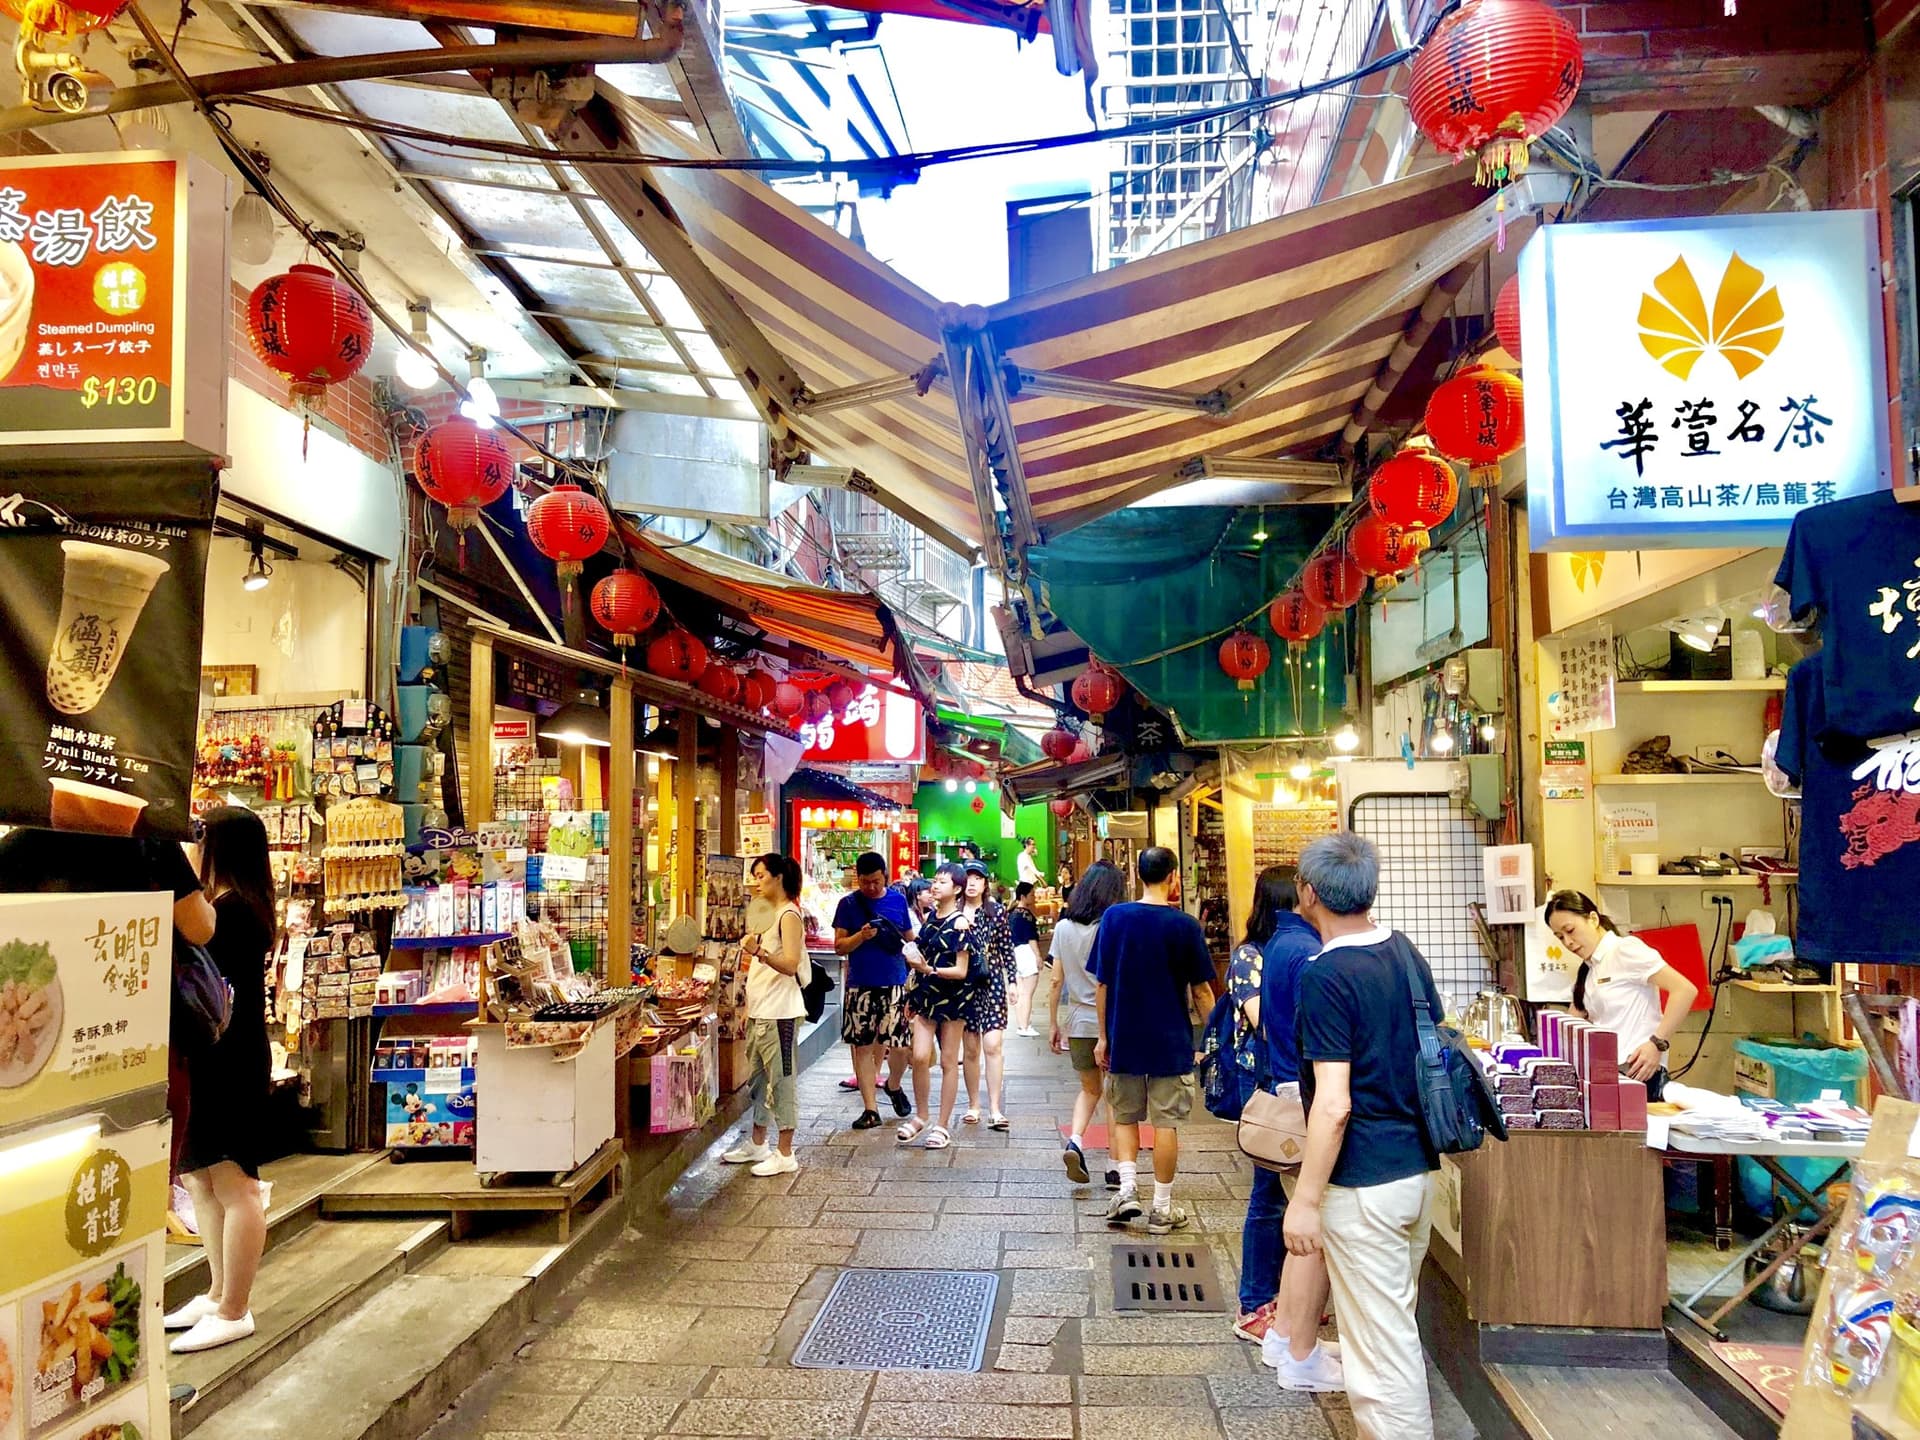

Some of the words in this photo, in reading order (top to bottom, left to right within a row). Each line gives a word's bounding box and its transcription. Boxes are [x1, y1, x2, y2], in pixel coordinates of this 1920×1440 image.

[38, 322, 93, 335] Steamed
[95, 320, 155, 335] Dumpling
[81, 376, 157, 409] $130
[1600, 394, 1833, 478] 華萱名茶
[1606, 481, 1837, 510] 台灣高山茶/烏龍茶
[1137, 722, 1163, 746] 茶
[42, 756, 134, 785] フルーツティー
[46, 741, 79, 759] Fruit
[82, 749, 119, 767] Black
[124, 758, 149, 773] Tea
[1610, 816, 1654, 828] aiwan
[77, 1161, 119, 1208] 招牌
[82, 1197, 123, 1244] 首選
